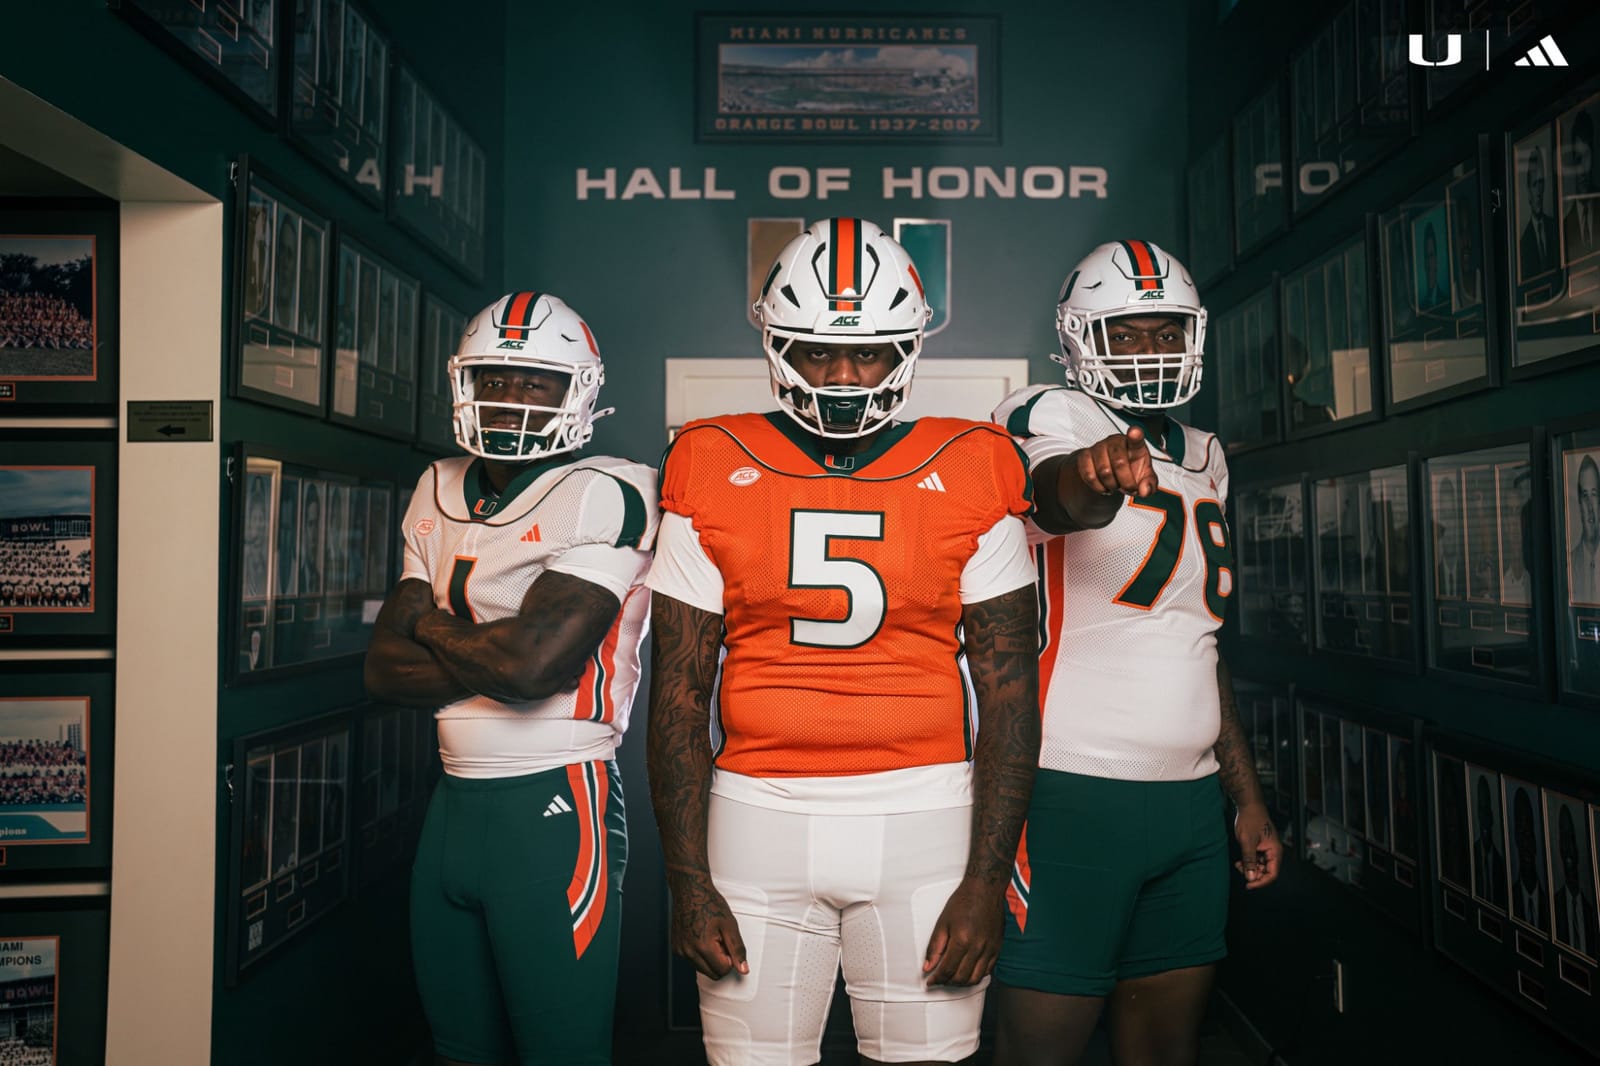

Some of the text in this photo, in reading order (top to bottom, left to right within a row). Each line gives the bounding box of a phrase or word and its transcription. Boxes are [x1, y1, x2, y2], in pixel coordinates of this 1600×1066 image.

[730, 26, 967, 40] MIAMI HURRICANES
[714, 118, 981, 131] ORANGE BOWL 1937-2007
[576, 165, 1108, 200] HALL OF HONOR
[1138, 290, 1165, 301] ACC
[828, 315, 861, 327] ACC
[496, 340, 526, 351] ACC
[824, 454, 855, 471] U
[473, 498, 498, 516] U
[11, 522, 50, 533] BOWL
[1111, 486, 1234, 624] 78
[788, 508, 888, 650] 5
